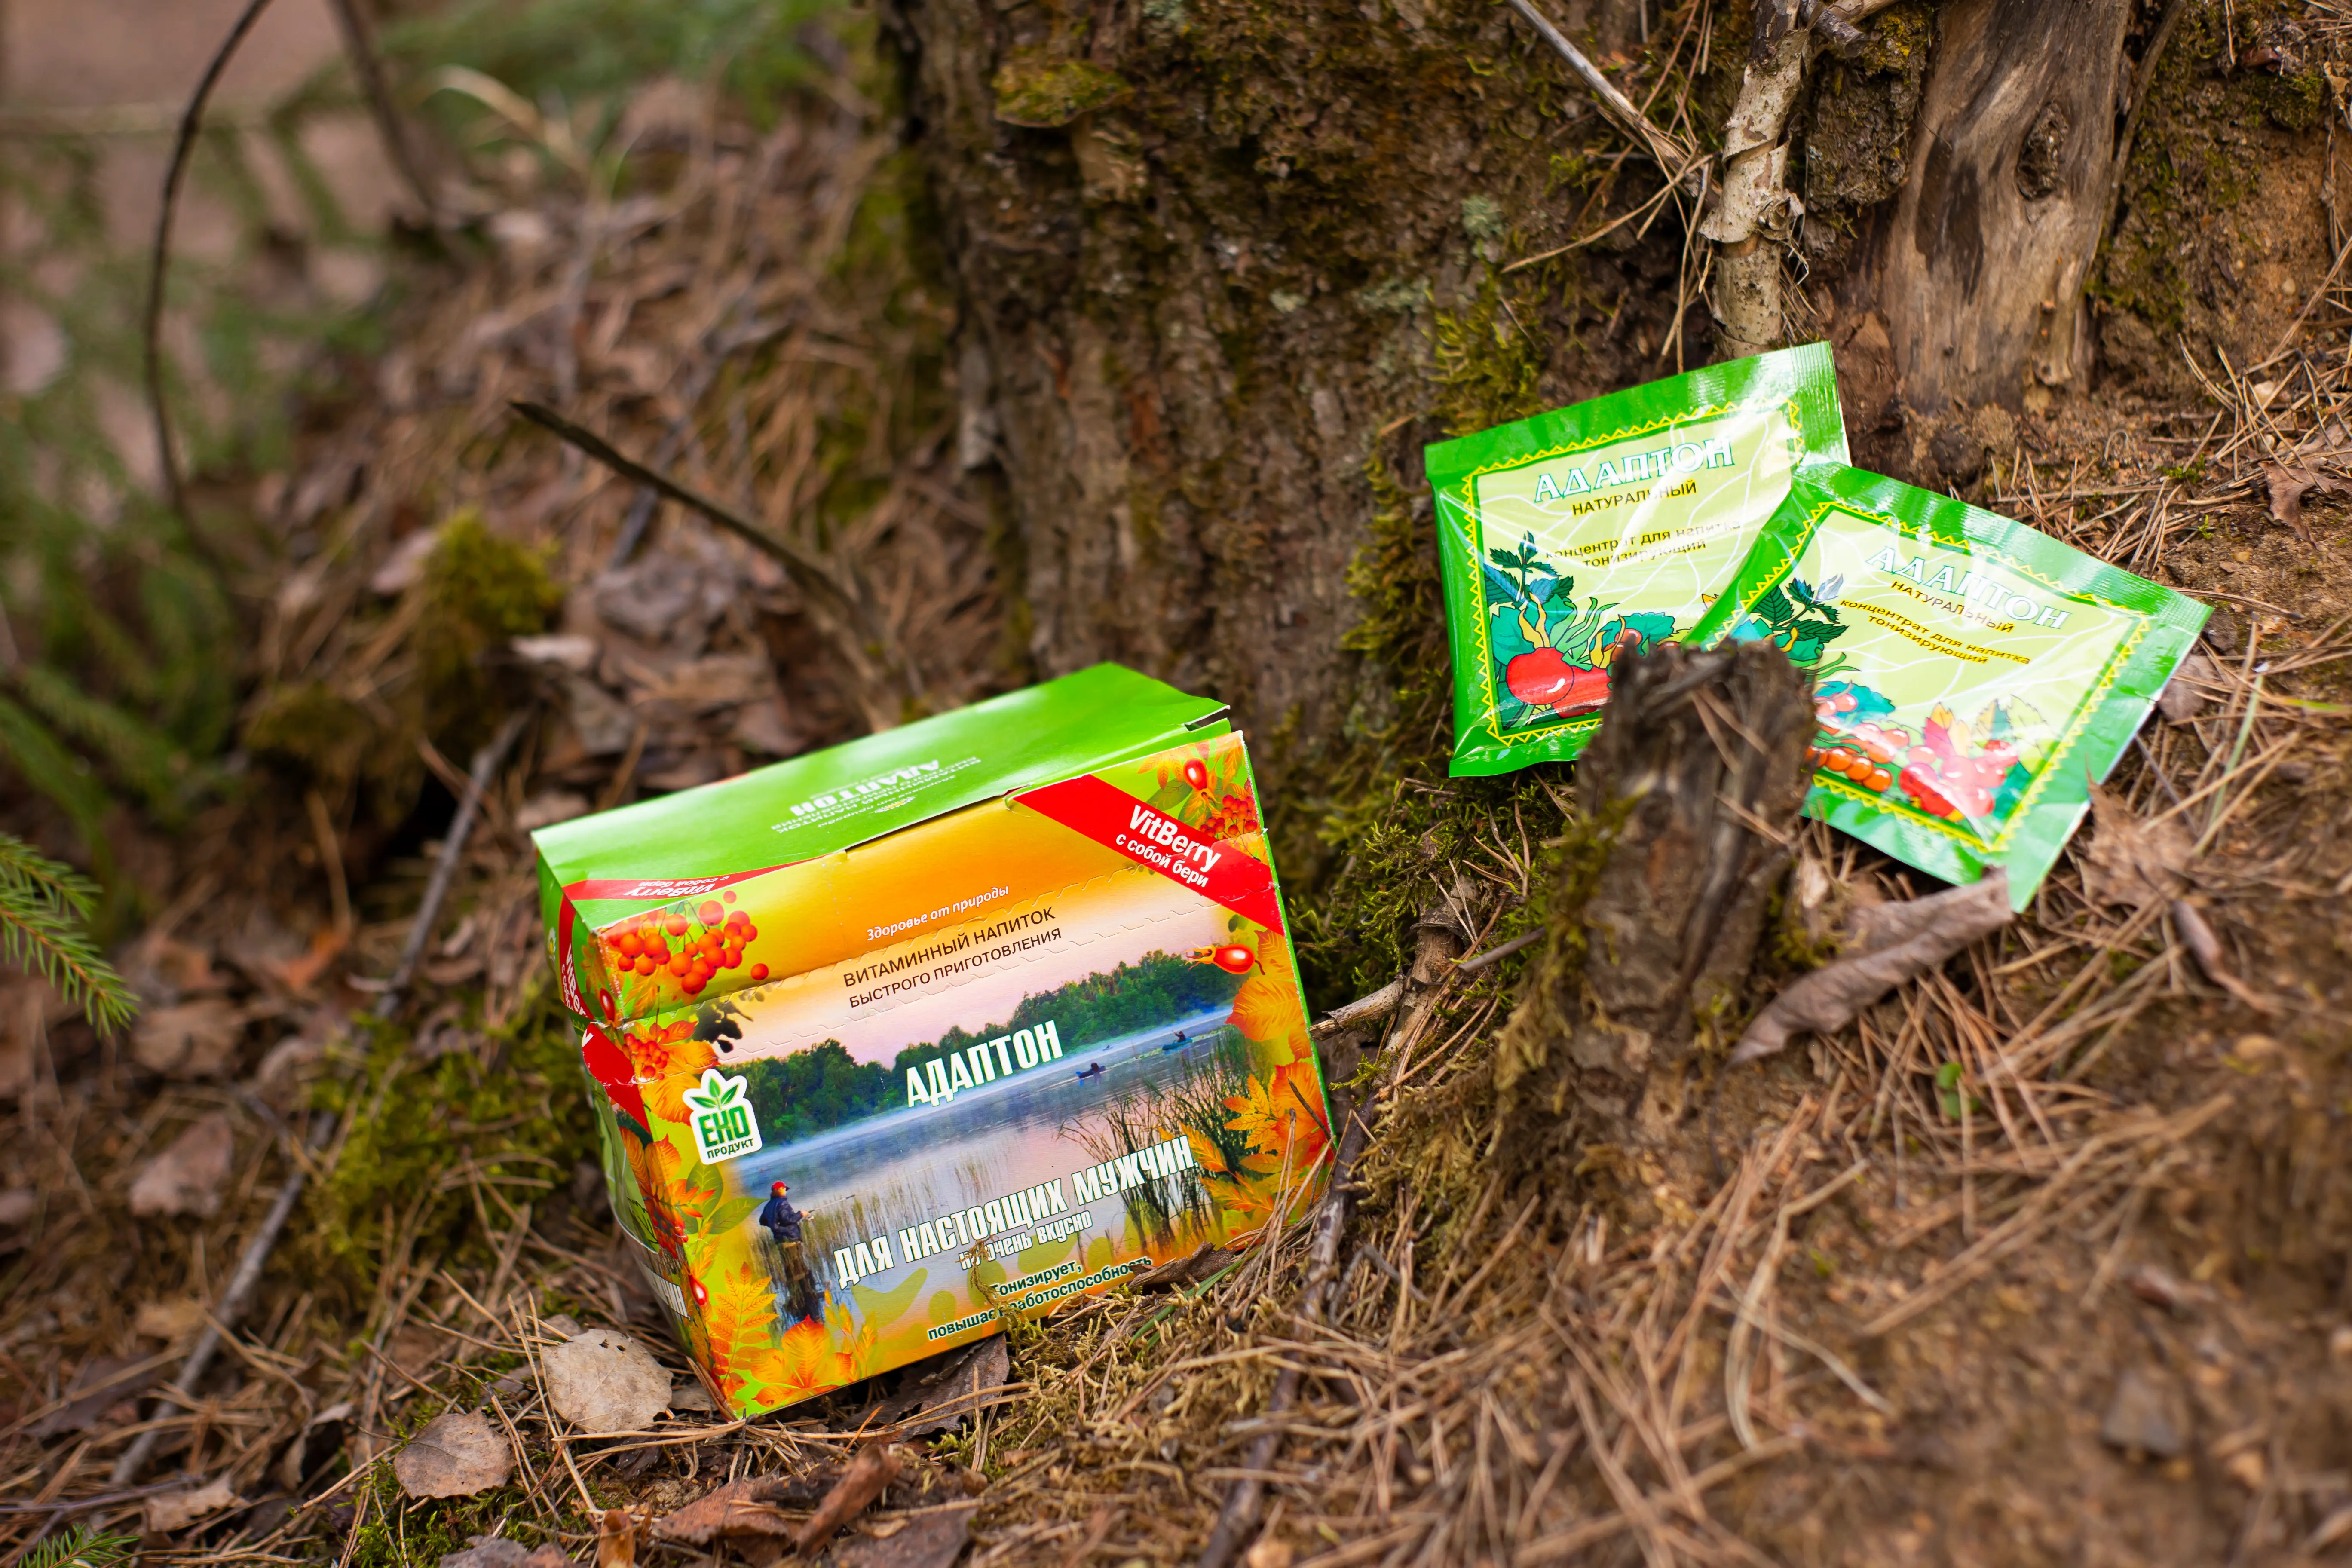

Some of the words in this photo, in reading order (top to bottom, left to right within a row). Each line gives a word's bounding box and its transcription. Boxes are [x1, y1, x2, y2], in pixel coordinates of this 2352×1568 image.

[1534, 435, 1735, 503] АДАПТОН
[1583, 539, 1706, 567] тонизирующий
[1641, 530, 1671, 546] для
[1865, 546, 2072, 629] АДАПТОН
[1891, 581, 2015, 633] НАТУРАЛЬНЫЙ
[1840, 600, 1930, 634] концентрат
[1929, 632, 1962, 648] для
[1966, 643, 2031, 665] напитка
[1868, 615, 1989, 664] тонизирующий
[790, 759, 939, 816] АДАПТОН
[861, 759, 981, 806] ВИТАМИННЫЙ
[777, 802, 858, 833] НАПИТОК
[1129, 805, 1222, 873] VitBerry
[674, 878, 719, 887] собой
[1116, 833, 1126, 845] с
[1127, 839, 1171, 868] собой
[1172, 859, 1209, 888] бери
[623, 883, 715, 897] VitBerry
[867, 913, 928, 942] Здоровье
[930, 906, 950, 920] от
[952, 885, 1009, 913] природы
[843, 932, 969, 987] ВИТАМИННЫЙ
[973, 906, 1056, 945] НАПИТОК
[849, 972, 931, 1008] БЫСТРОГО
[934, 928, 1062, 980] ПРИГОТОВЛЕНИЯ
[906, 1020, 1063, 1108] АДАПТОН
[707, 1138, 753, 1159] ПРОДУКТ
[833, 1234, 895, 1291] ДЛЯ
[898, 1177, 1069, 1264] НАСТОЯЩИХ
[1071, 1134, 1200, 1207] МУЖЧИН,
[985, 1231, 1033, 1262] очень
[1035, 1210, 1093, 1244] вкусно
